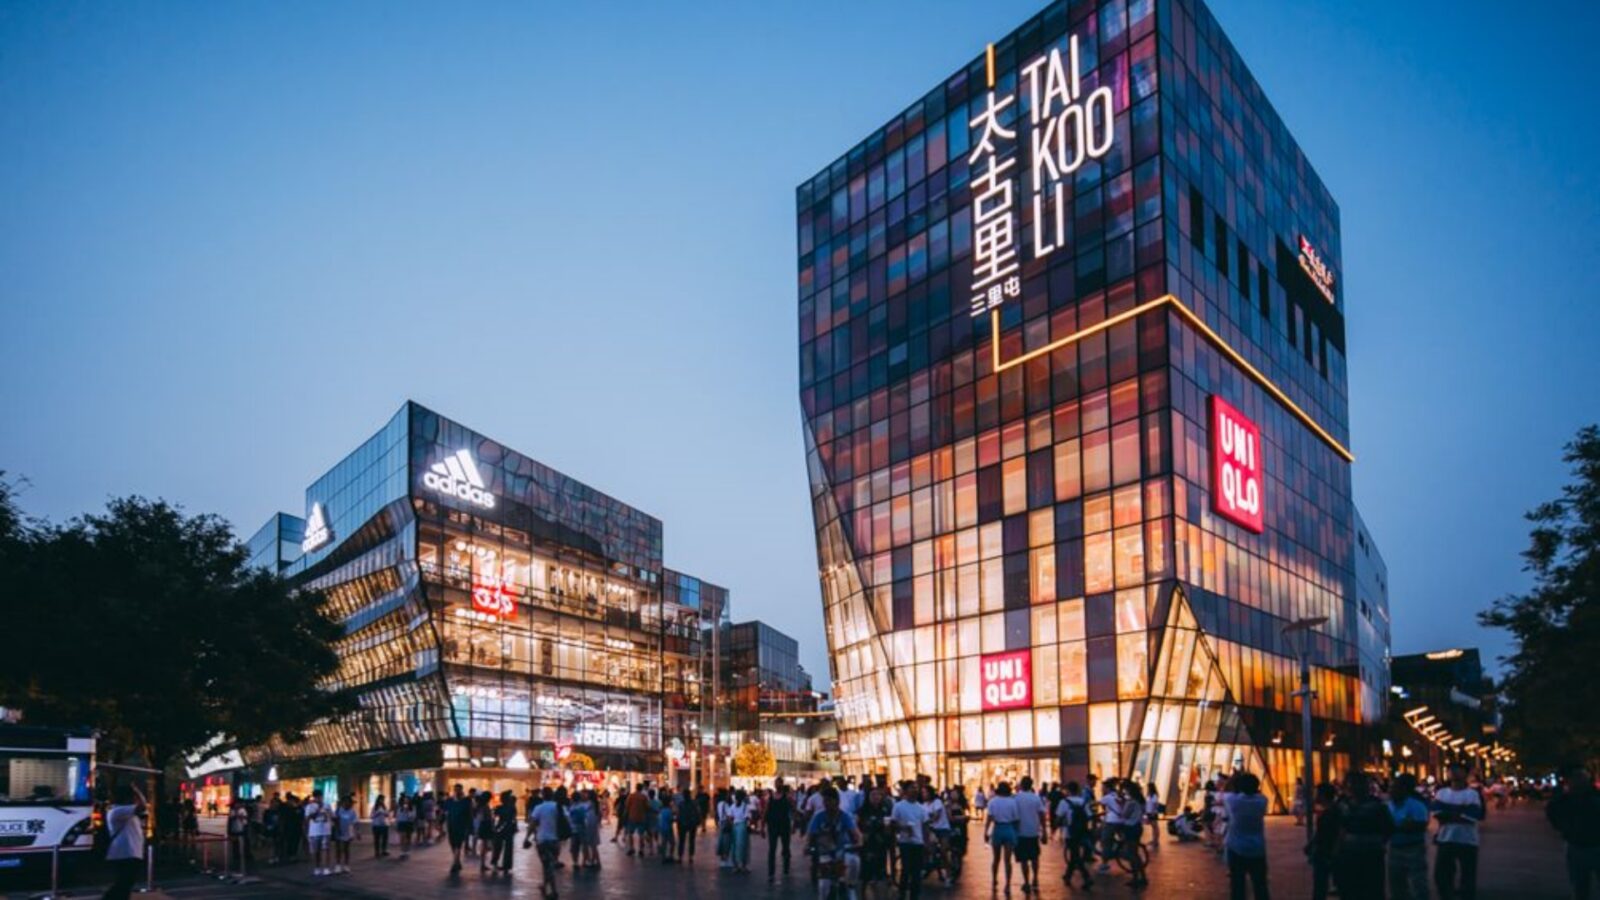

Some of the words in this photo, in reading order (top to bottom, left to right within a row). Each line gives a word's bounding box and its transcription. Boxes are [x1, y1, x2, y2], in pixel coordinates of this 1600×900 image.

[1021, 34, 1079, 125] TAI
[1032, 85, 1114, 192] KOO
[968, 91, 1019, 291] 太古里
[1033, 182, 1065, 259] LI
[969, 275, 1021, 318] 三里屯
[1219, 412, 1255, 471] UNI
[423, 471, 496, 509] adidas
[1221, 461, 1259, 516] QLO
[985, 658, 1022, 681] UNI
[985, 680, 1026, 706] QLO
